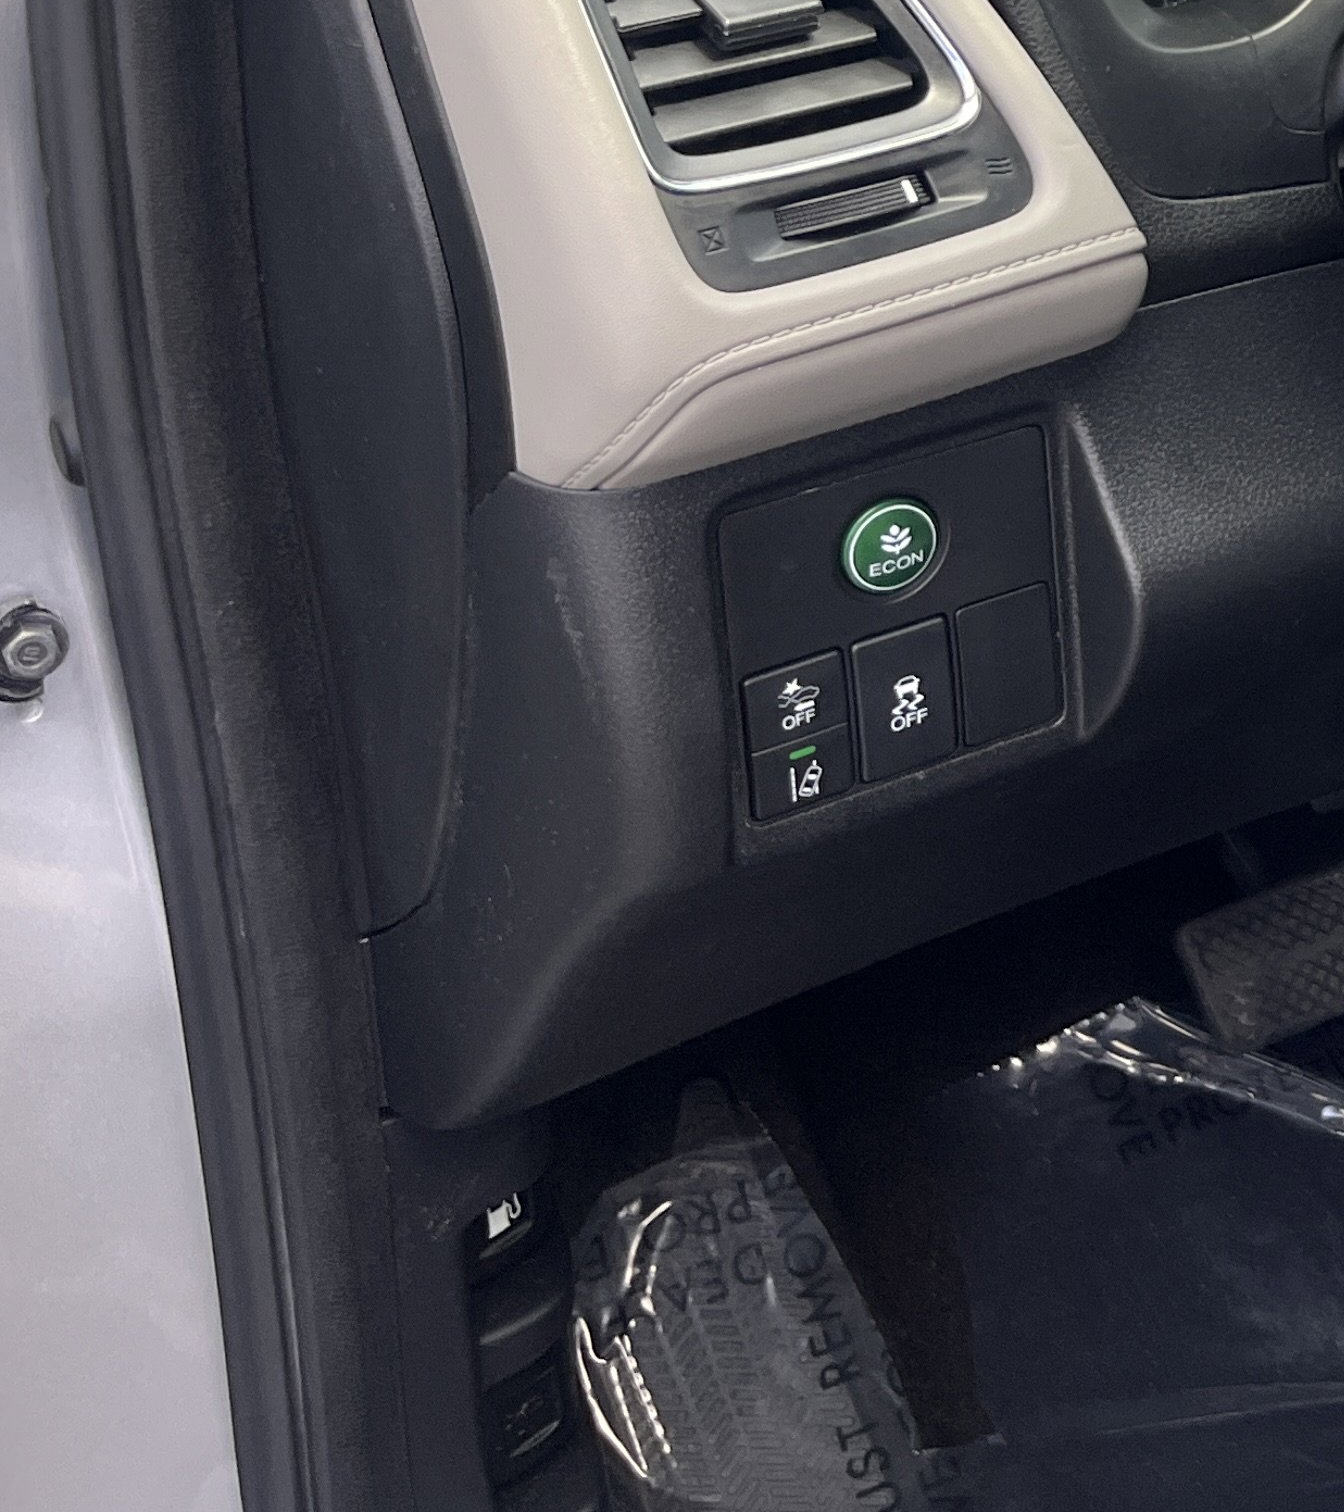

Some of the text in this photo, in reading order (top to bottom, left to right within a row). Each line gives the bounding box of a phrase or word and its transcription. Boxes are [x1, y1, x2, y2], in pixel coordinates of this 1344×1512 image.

[868, 550, 925, 578] ECON
[782, 708, 816, 731] OFF
[890, 707, 928, 732] OFF
